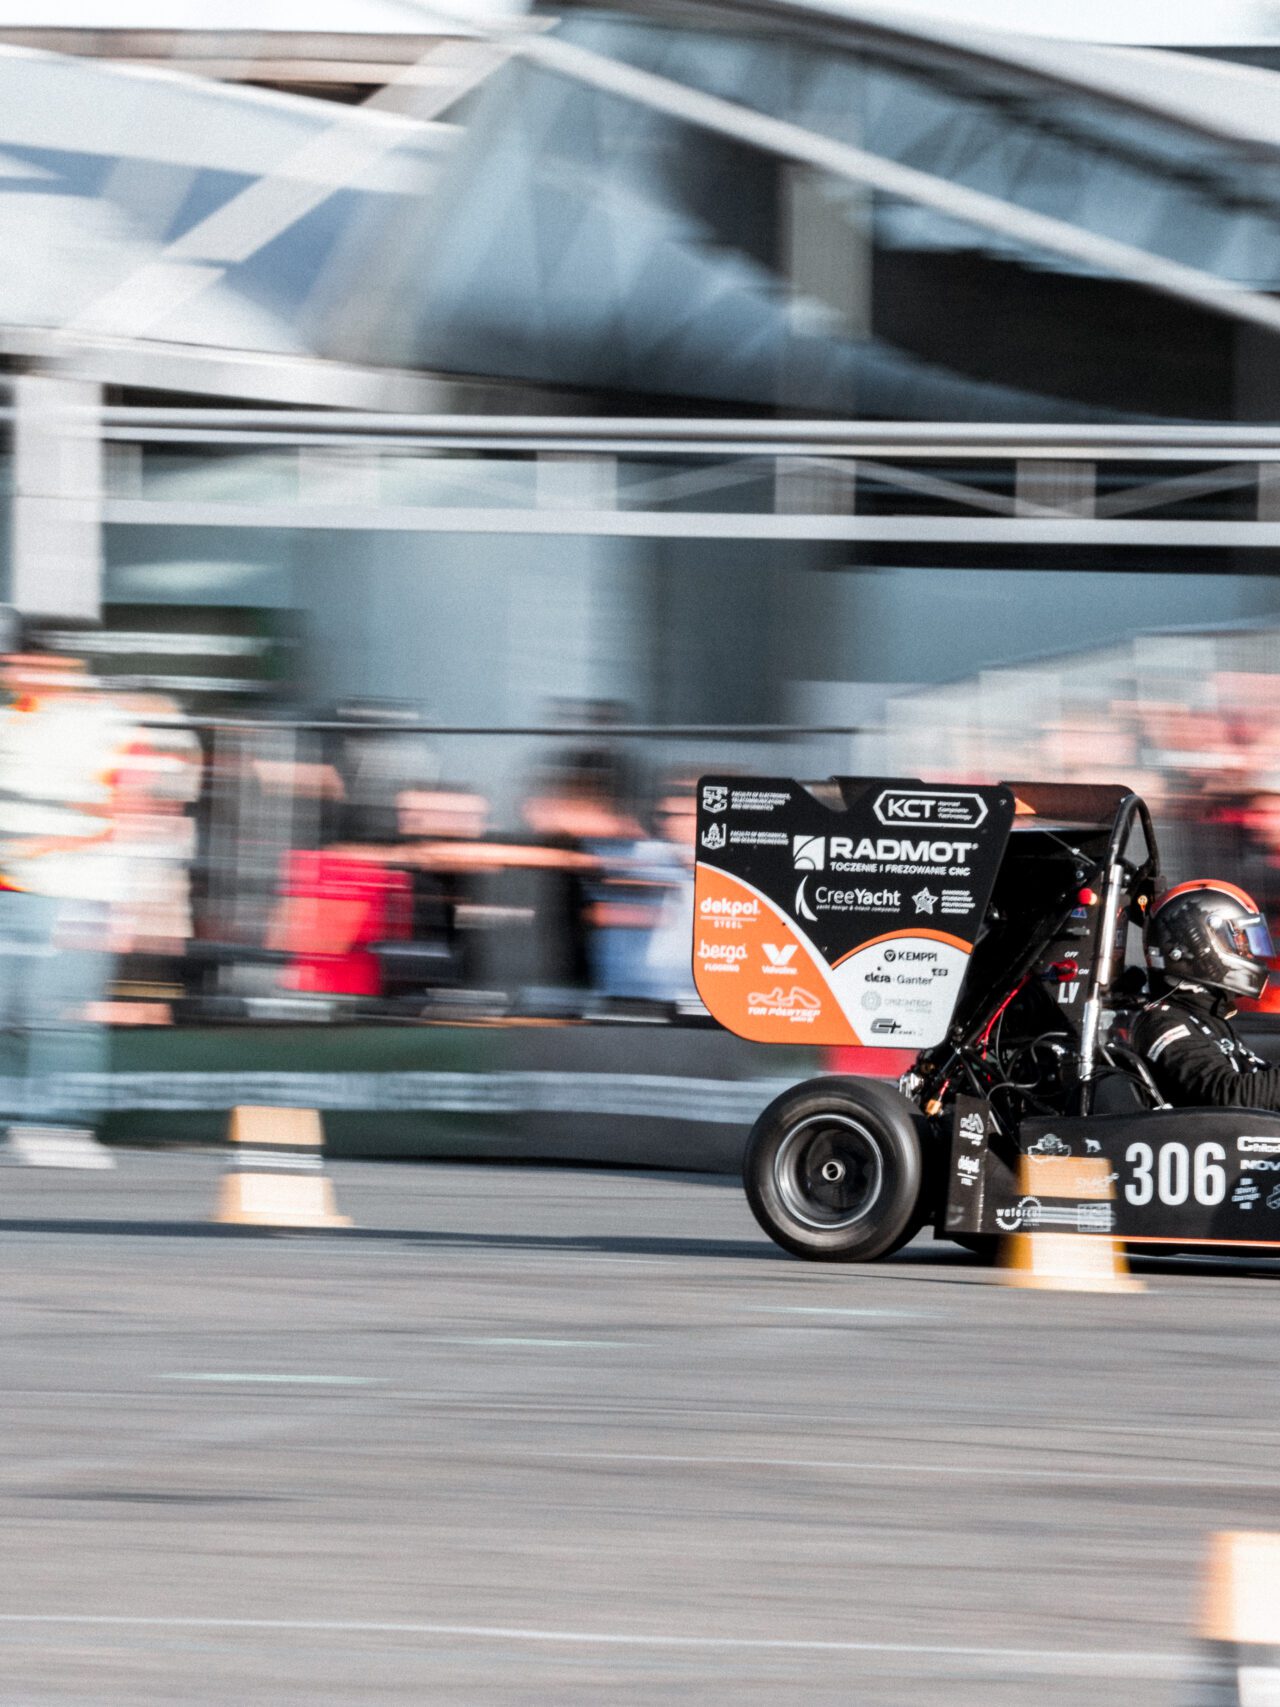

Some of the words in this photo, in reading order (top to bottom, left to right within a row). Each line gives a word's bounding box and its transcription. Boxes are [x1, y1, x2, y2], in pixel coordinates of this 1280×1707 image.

[888, 799, 937, 819] KCT
[830, 836, 972, 864] RADMOT
[830, 861, 877, 873] TOCZENIE
[885, 864, 947, 875] FREZOWANIE
[948, 866, 971, 877] CNC
[815, 886, 901, 907] CreeYacht
[700, 897, 758, 917] dekpol
[713, 920, 743, 929] STEEL
[898, 951, 938, 962] KEMPPI
[1064, 950, 1079, 959] OFF
[1078, 968, 1090, 976] ON
[1057, 981, 1080, 1004] LV
[1125, 1142, 1227, 1206] 306
